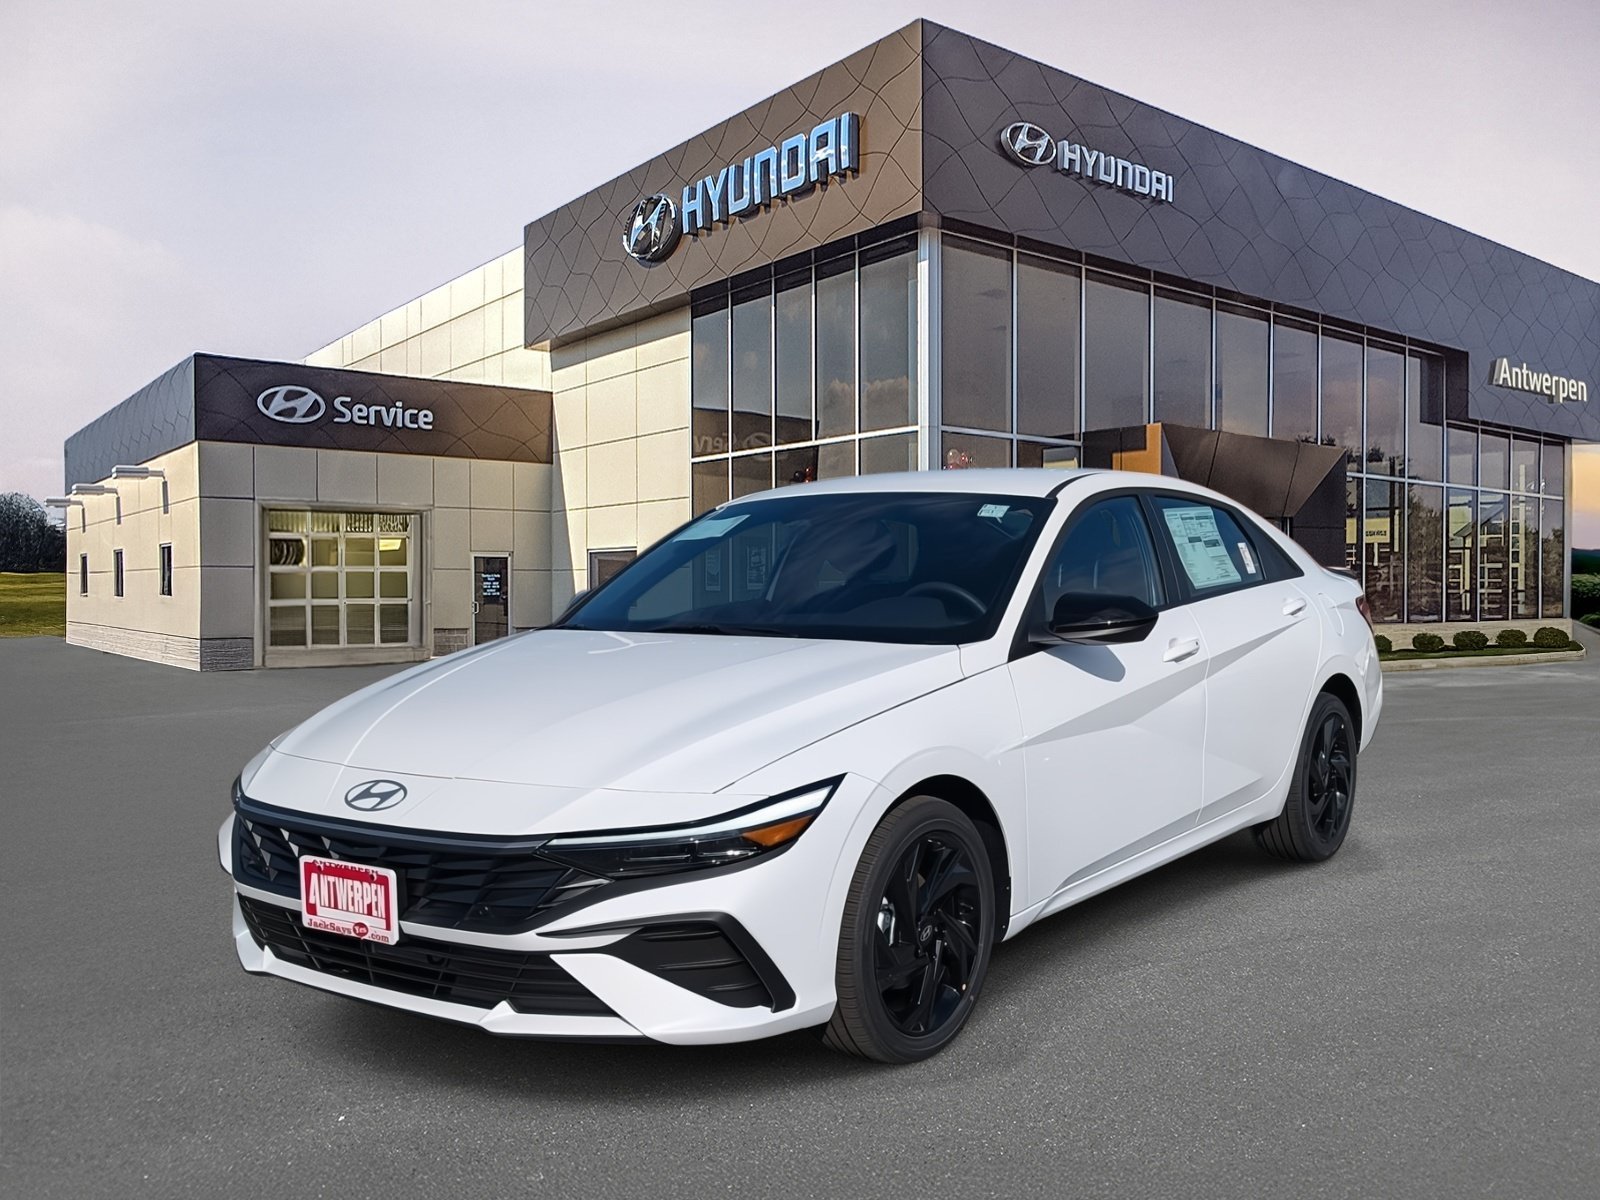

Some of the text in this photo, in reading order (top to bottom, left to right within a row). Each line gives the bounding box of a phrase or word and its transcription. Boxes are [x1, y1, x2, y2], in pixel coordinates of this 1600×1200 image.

[682, 112, 858, 235] HYUNDAI
[1057, 139, 1174, 203] HYUNDAI
[1493, 357, 1587, 404] Antwerpen
[333, 396, 434, 430] Service
[308, 872, 386, 920] ANTWERPEN
